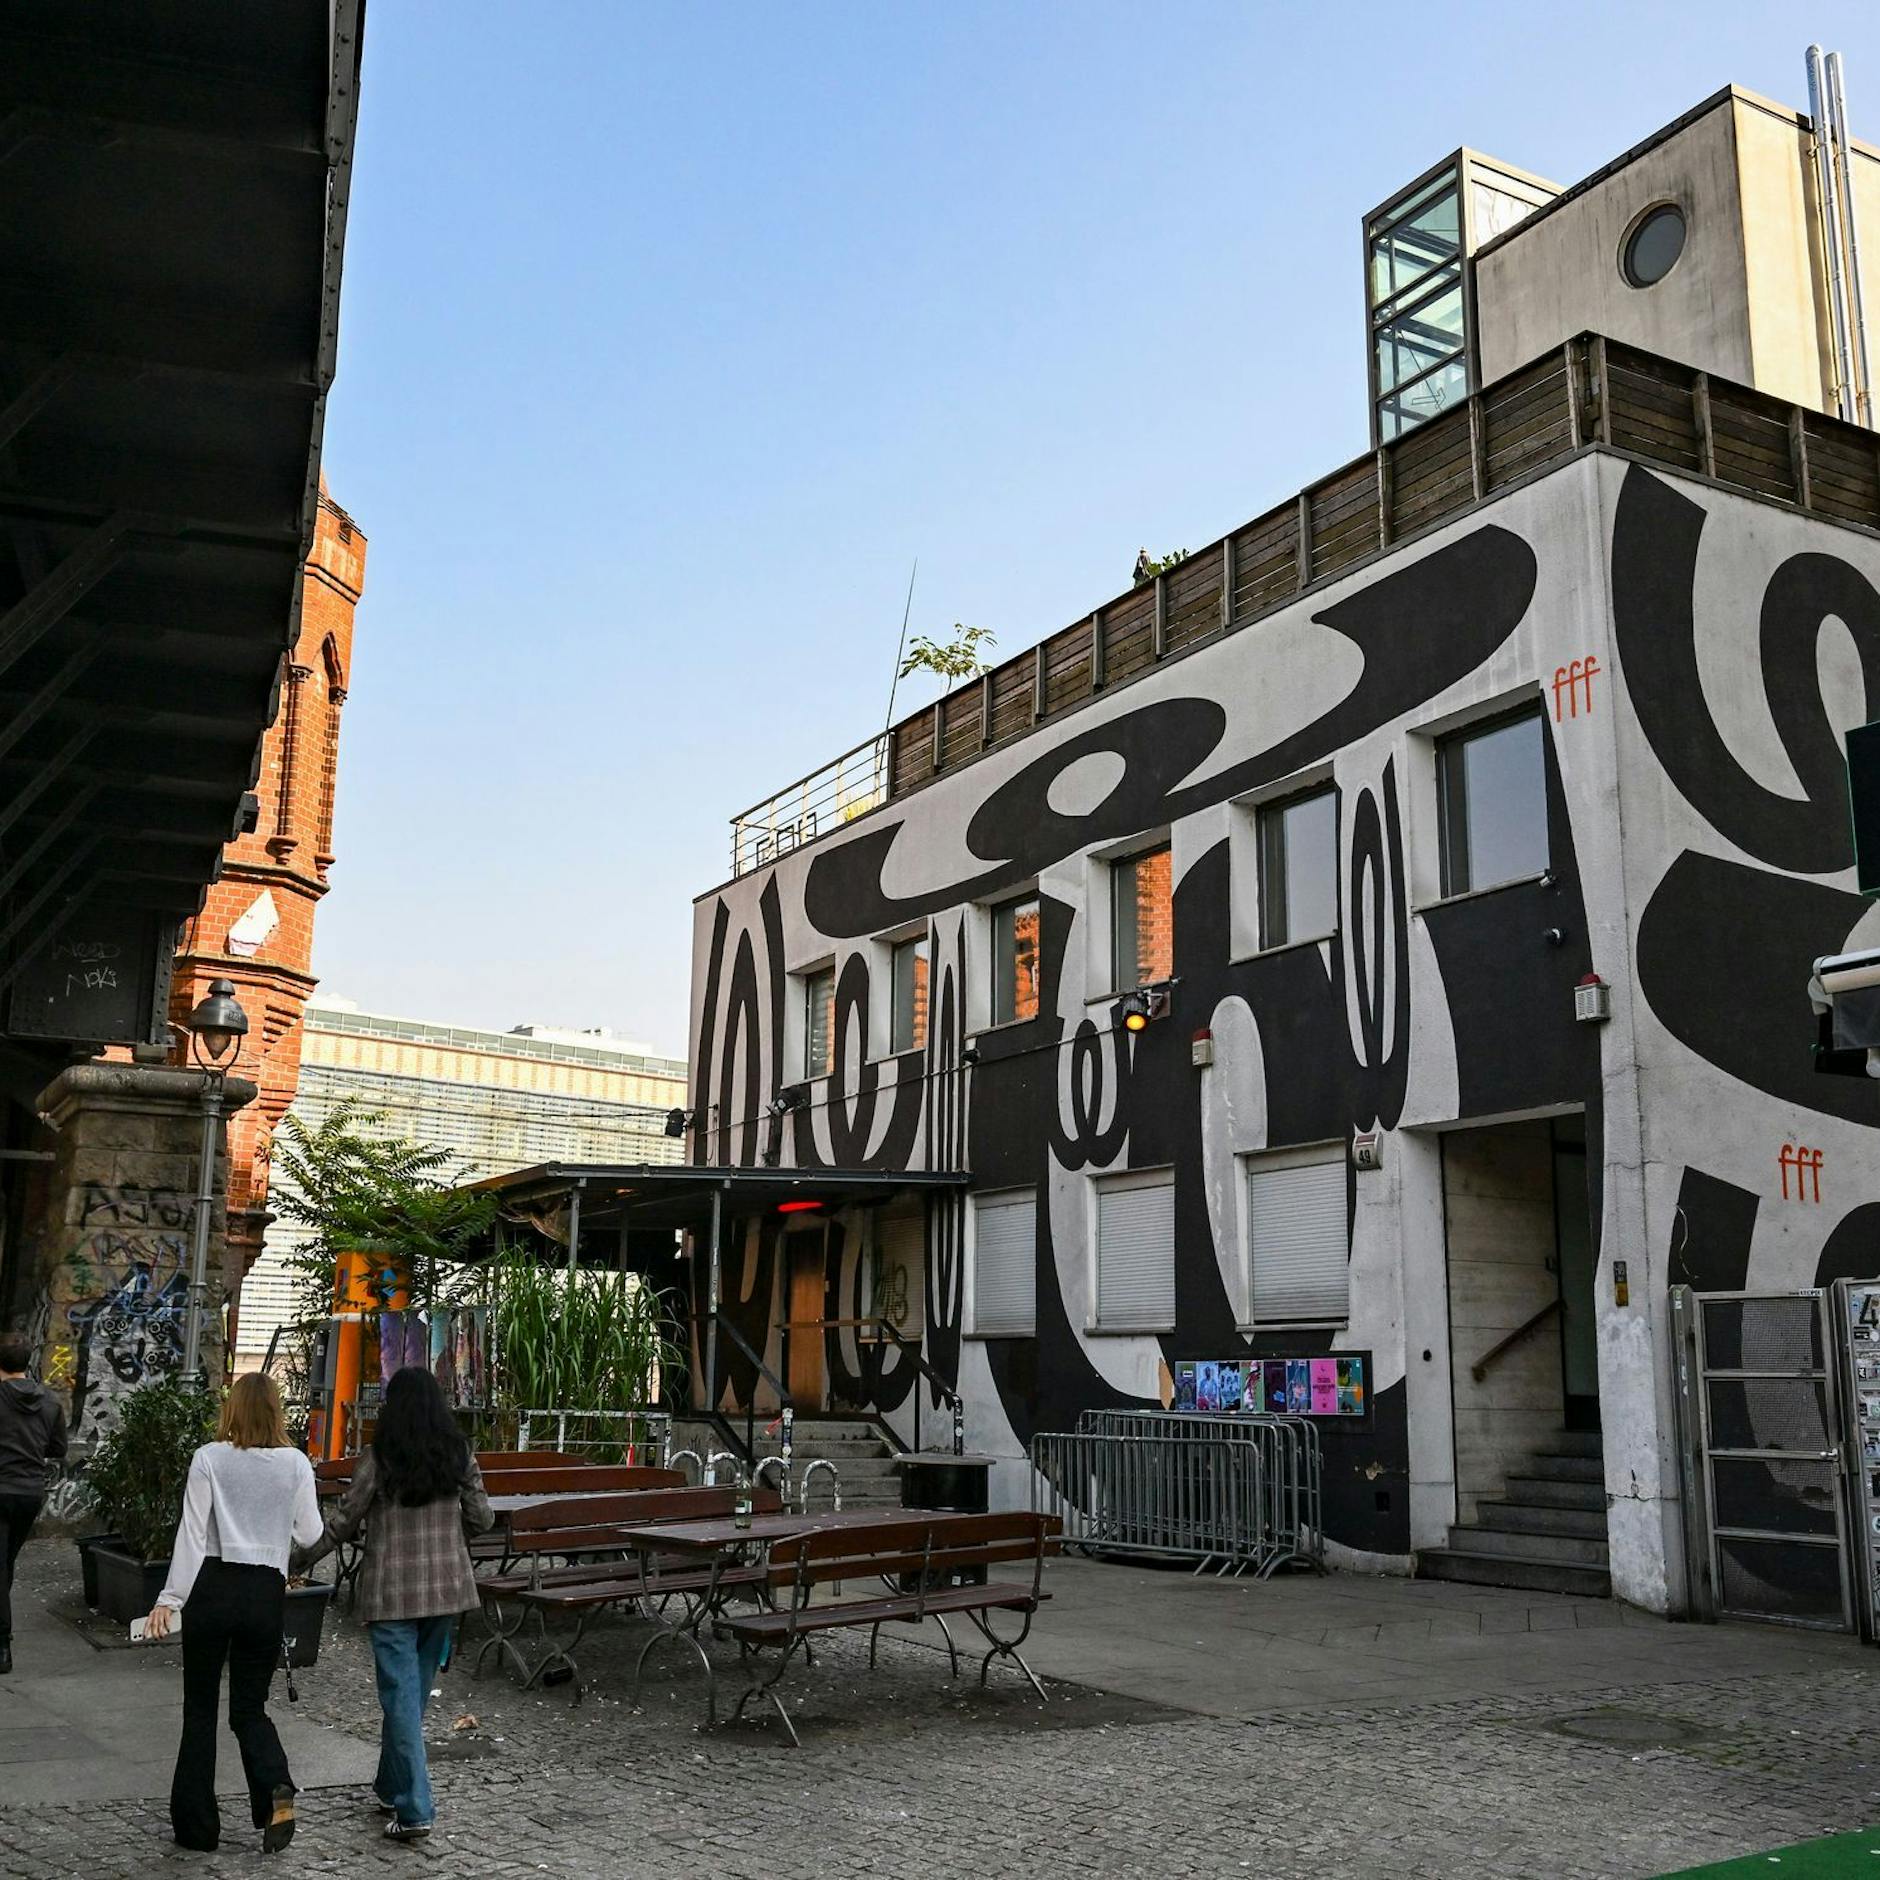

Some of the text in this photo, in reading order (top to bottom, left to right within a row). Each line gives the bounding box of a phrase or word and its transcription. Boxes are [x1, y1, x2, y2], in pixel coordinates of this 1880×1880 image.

[1552, 655, 1600, 723] fff
[1359, 1149, 1371, 1163] 49
[1778, 1143, 1823, 1203] fff
